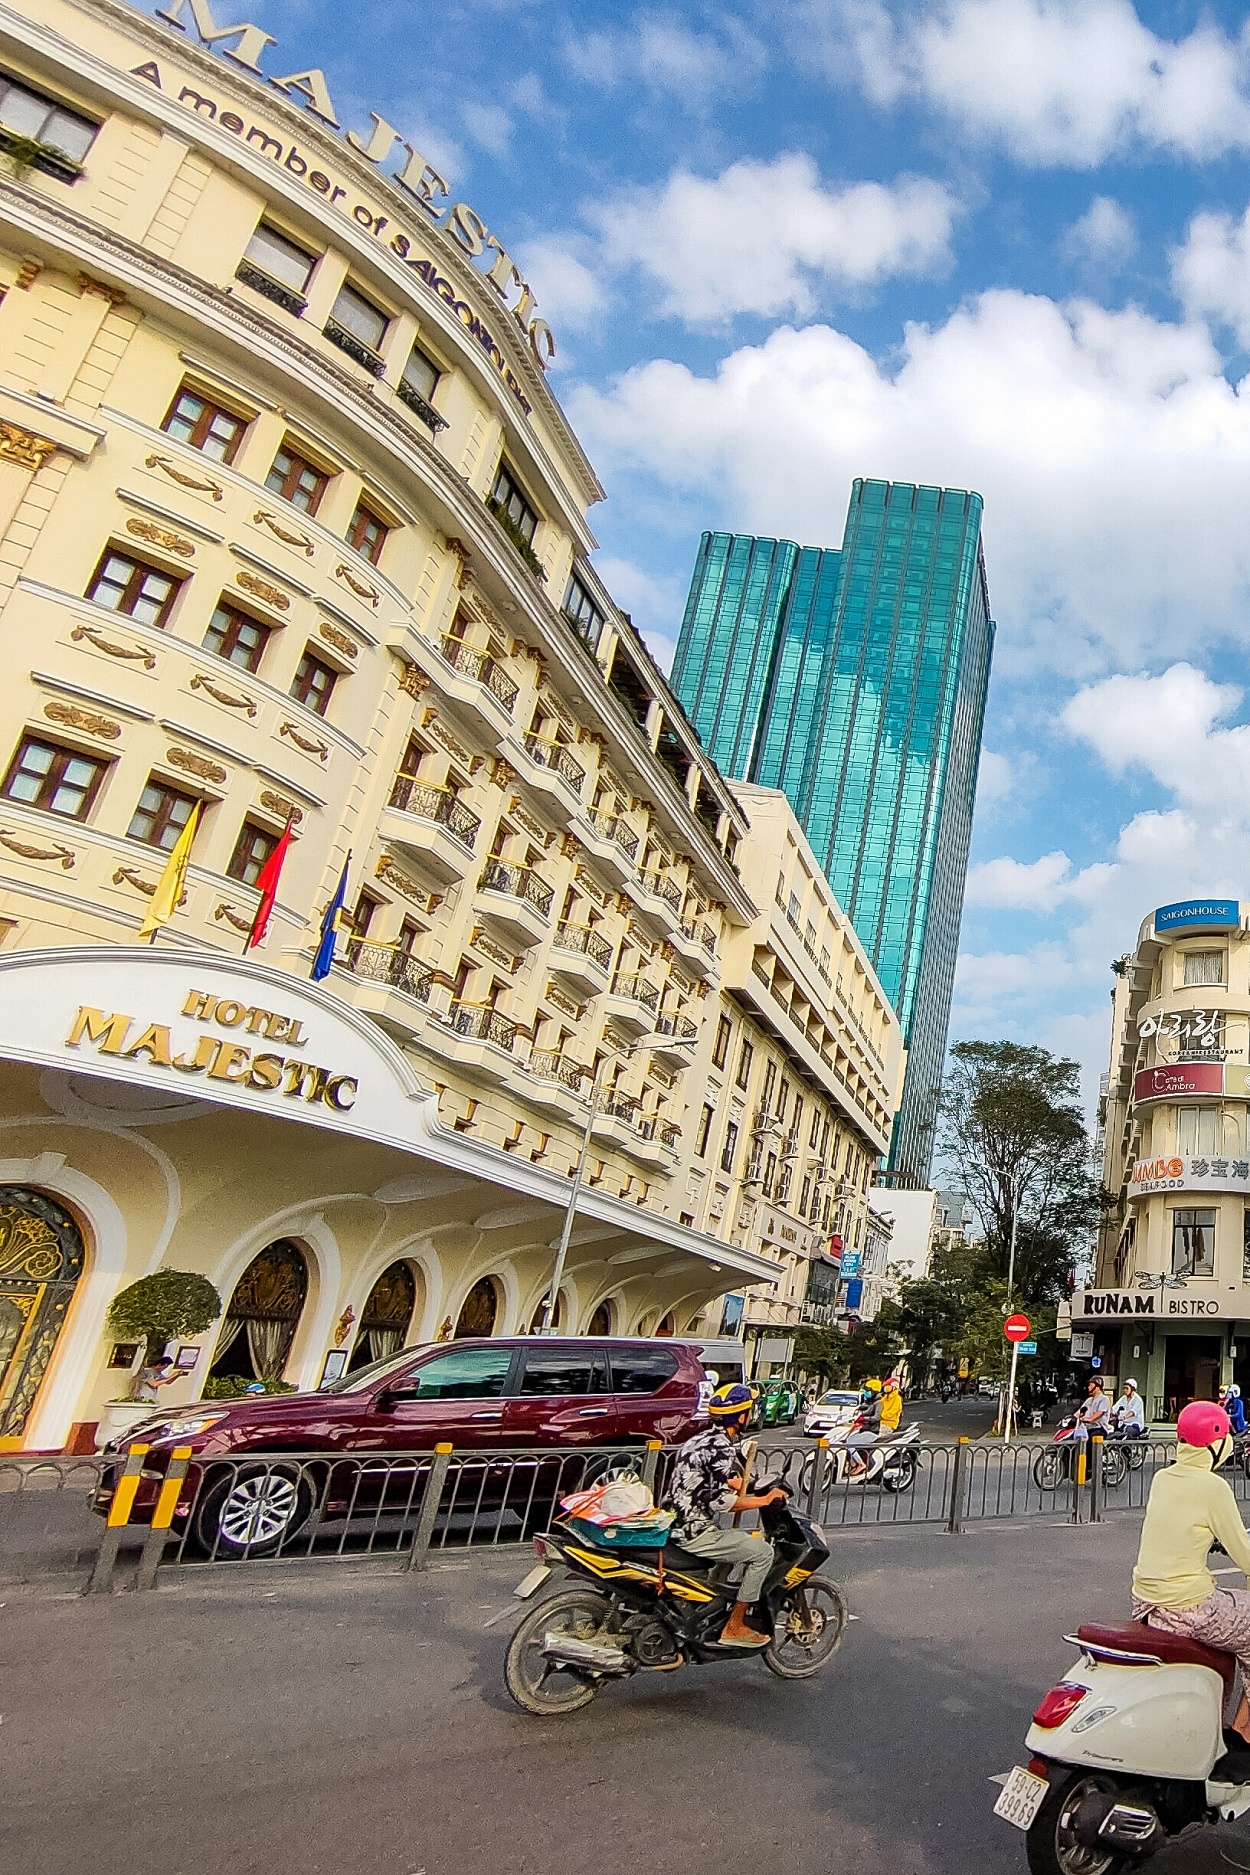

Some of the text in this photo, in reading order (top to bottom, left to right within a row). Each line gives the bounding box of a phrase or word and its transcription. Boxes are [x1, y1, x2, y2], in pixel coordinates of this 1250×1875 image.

[130, 61, 162, 89] A
[177, 86, 347, 206] member
[353, 205, 389, 237] of
[155, 0, 559, 373] MAJESTIC
[1160, 906, 1229, 922] SAIGONHOUSE
[180, 989, 309, 1047] HOTEL
[65, 1005, 359, 1112] MAJESTIC
[1166, 1082, 1196, 1092] Ambra
[1084, 1294, 1219, 1316] RUNAM BISTRO
